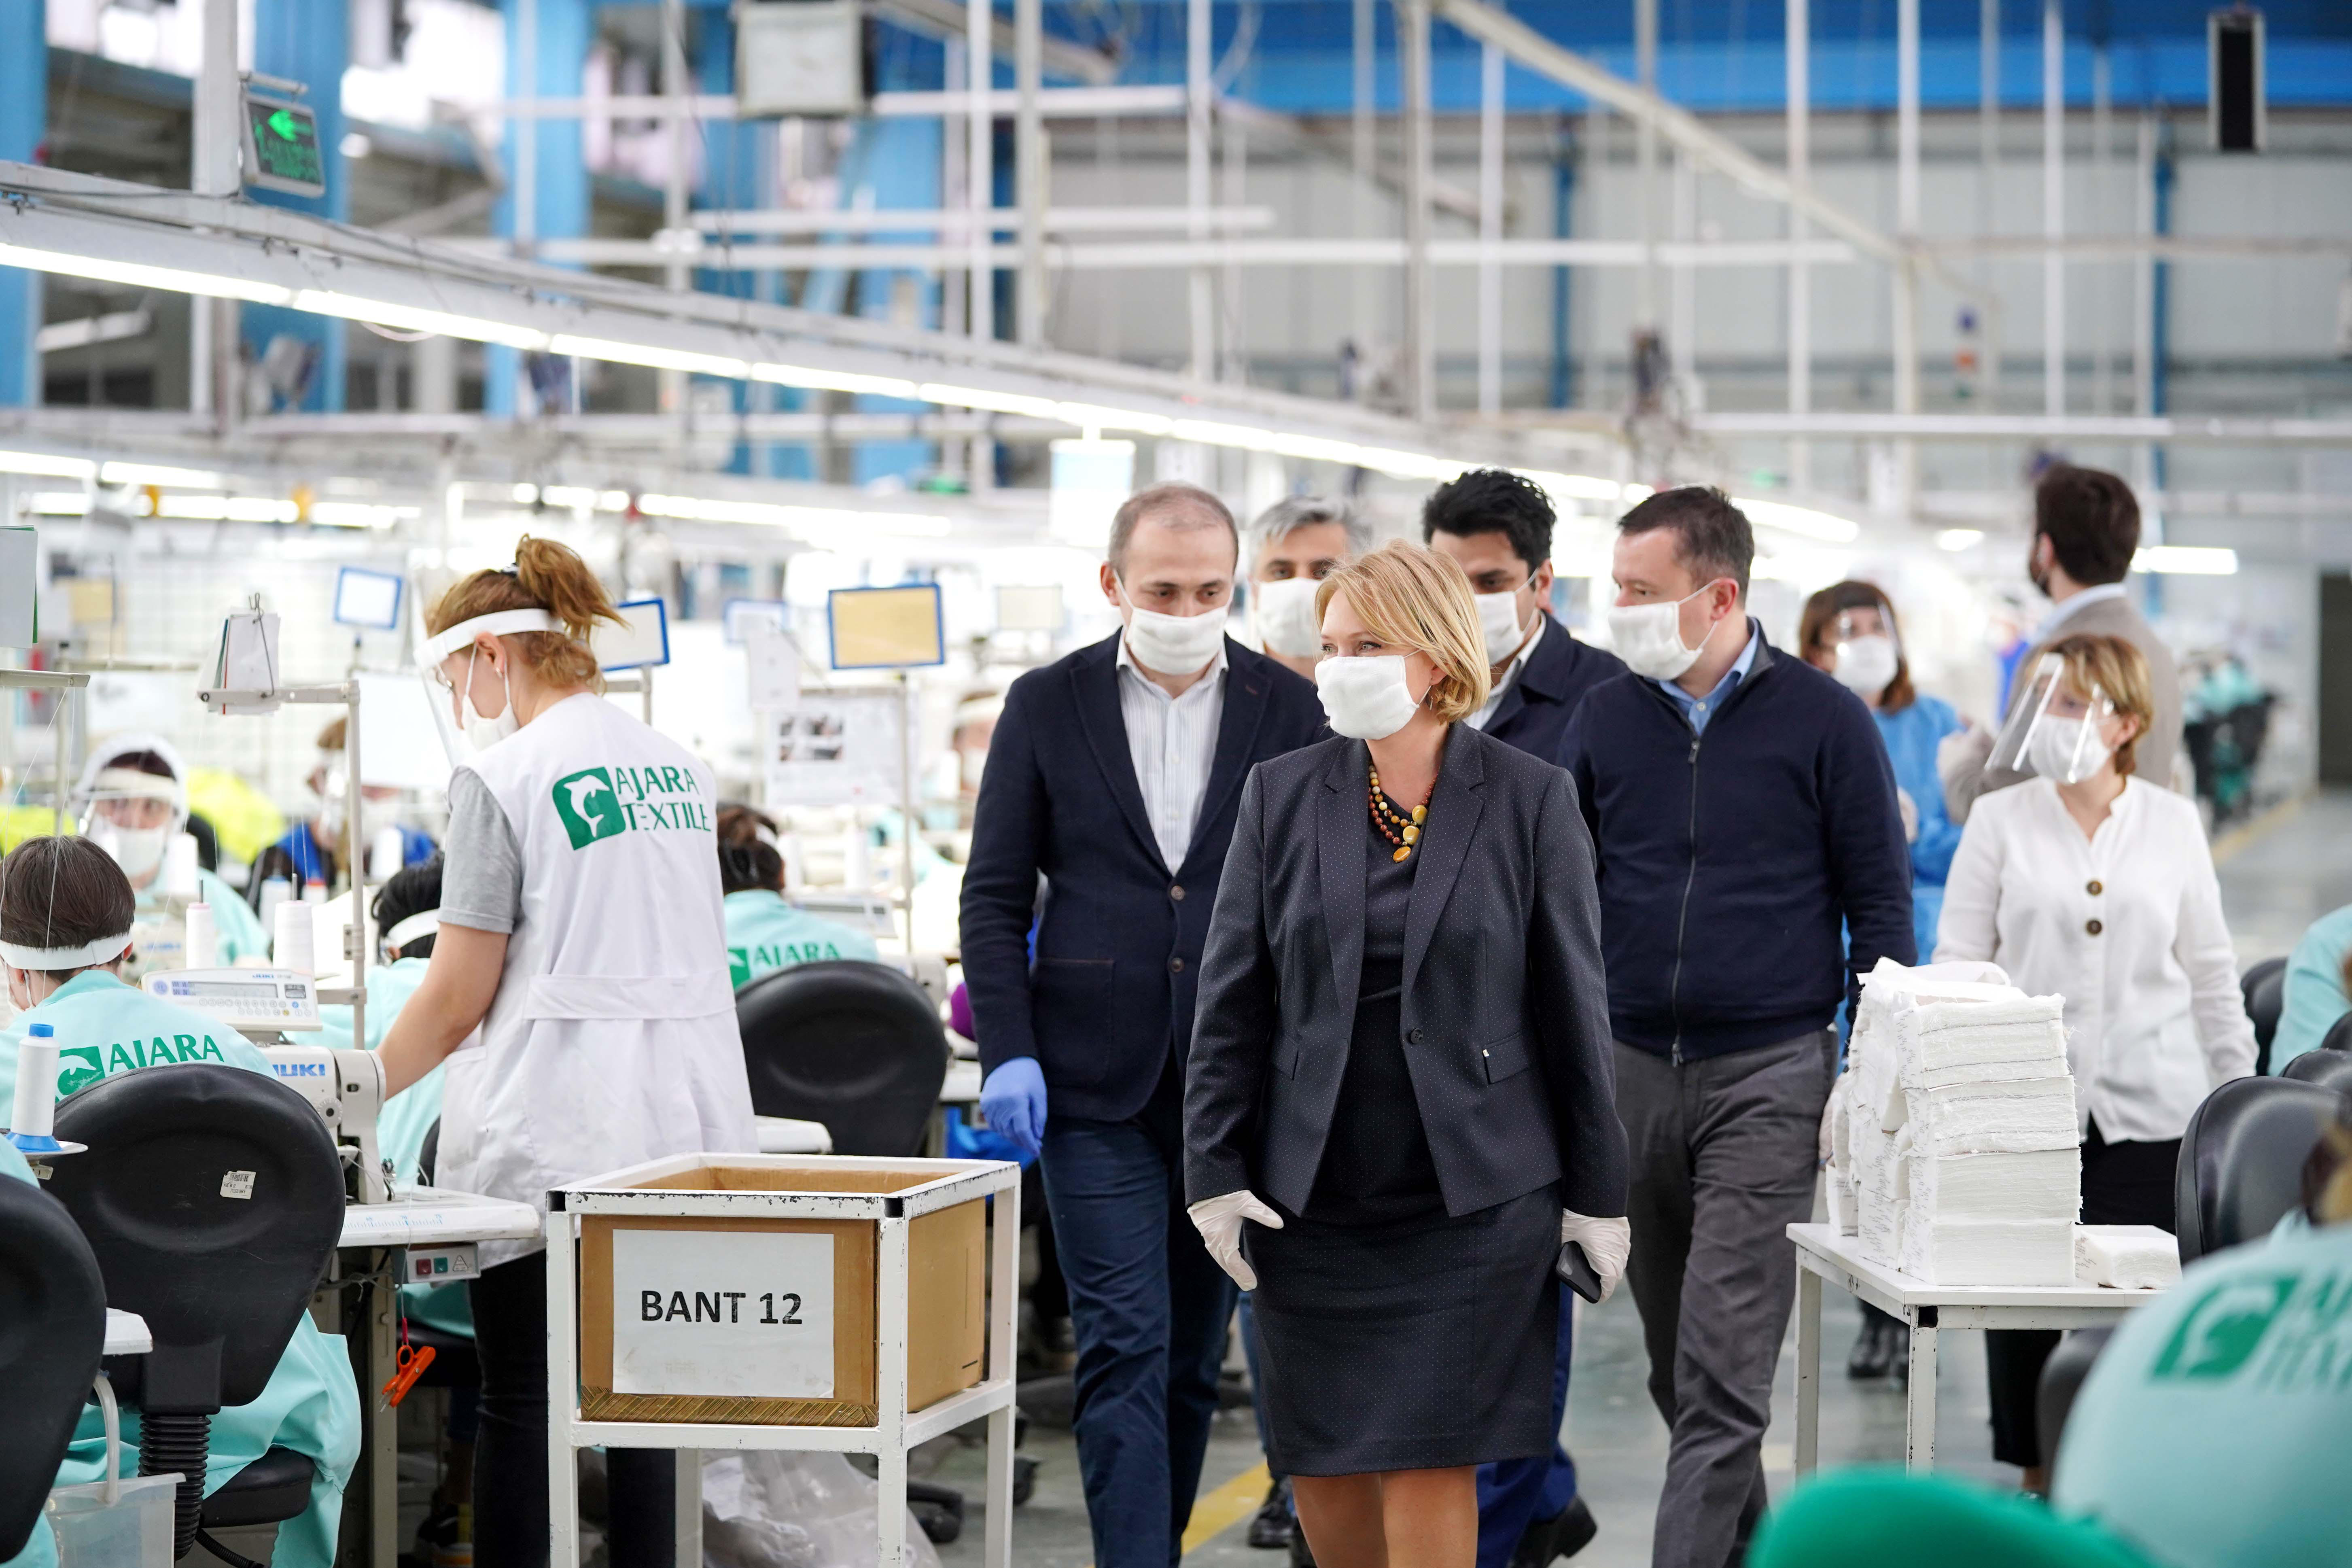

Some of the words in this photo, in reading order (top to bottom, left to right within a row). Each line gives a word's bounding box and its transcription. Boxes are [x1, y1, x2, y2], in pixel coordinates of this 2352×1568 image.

[615, 766, 700, 801] AJARA
[642, 1290, 746, 1323] BANT
[759, 1293, 802, 1324] 12
